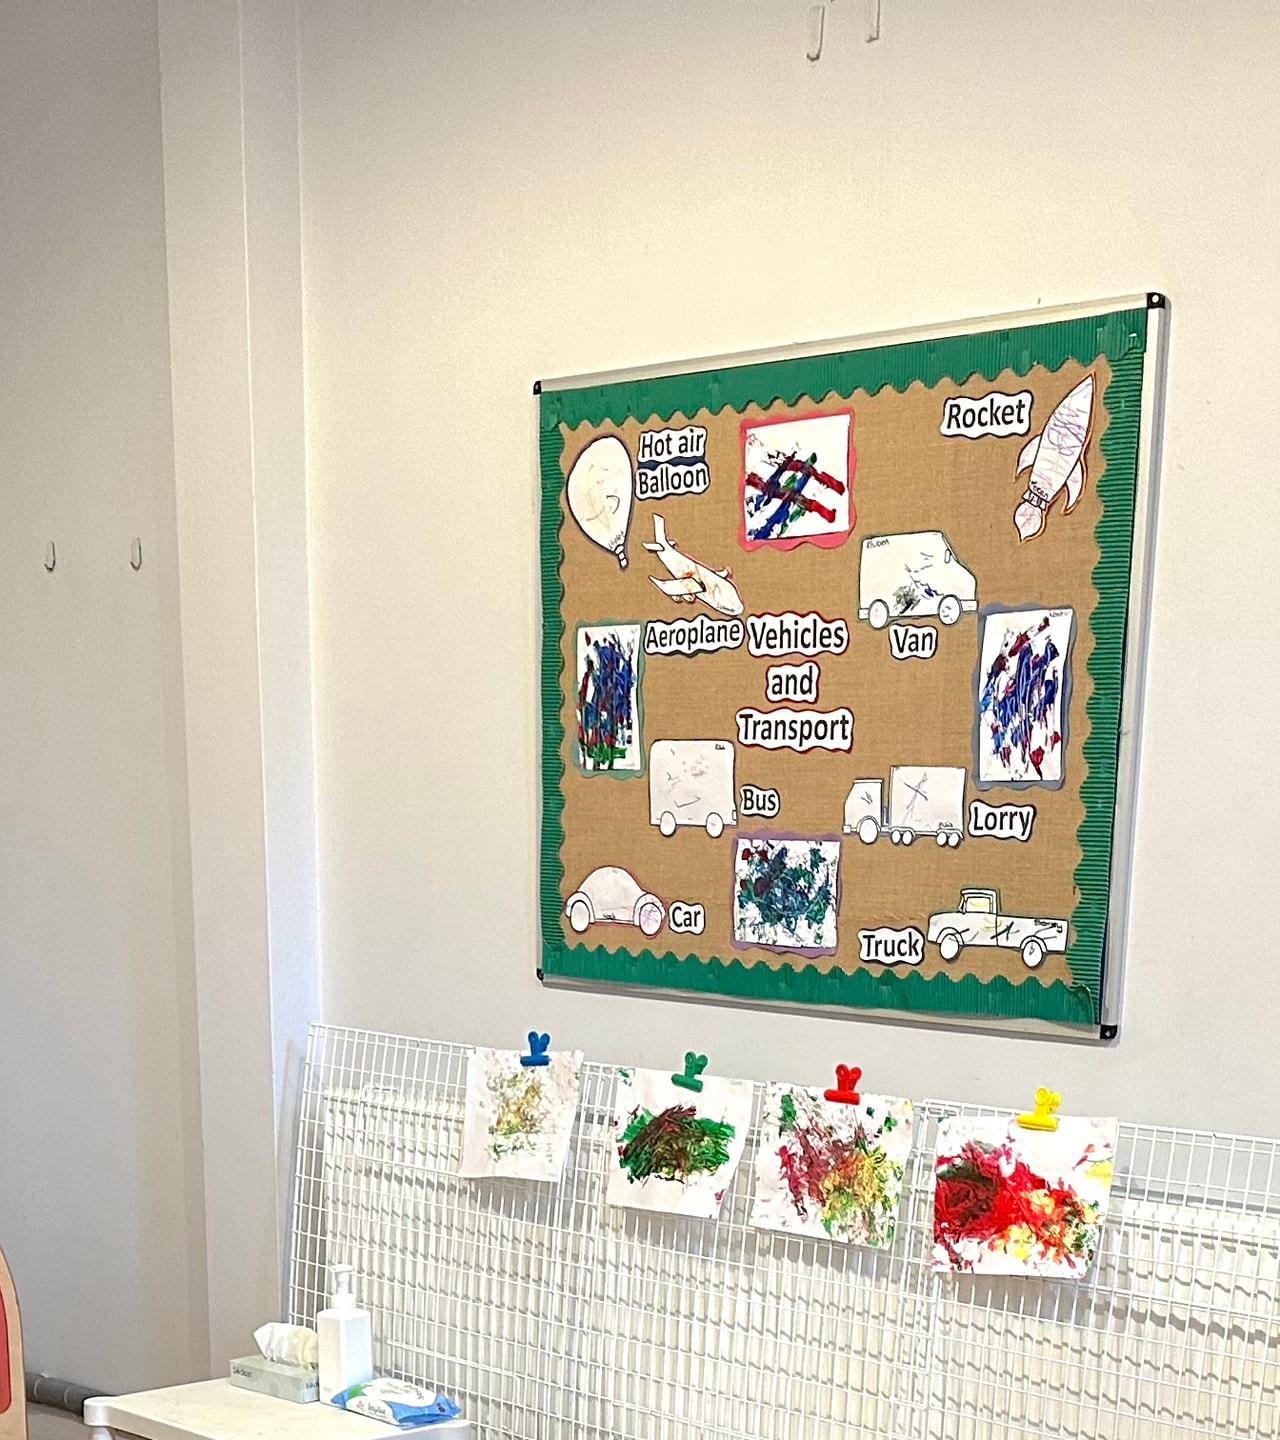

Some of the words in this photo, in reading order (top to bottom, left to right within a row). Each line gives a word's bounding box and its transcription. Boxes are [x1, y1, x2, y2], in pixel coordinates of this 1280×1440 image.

[947, 398, 1026, 429] Rocket
[641, 433, 673, 458] Hot
[678, 428, 704, 453] air
[638, 466, 707, 494] Balloon
[646, 619, 740, 650] Aeroplane
[750, 618, 845, 650] Vehicles
[893, 628, 933, 653] Van
[771, 665, 814, 696] and
[738, 713, 849, 747] Transport
[743, 788, 776, 811] Bus
[974, 806, 1030, 836] Lorry
[672, 905, 701, 928] Car
[862, 931, 919, 957] Truck
